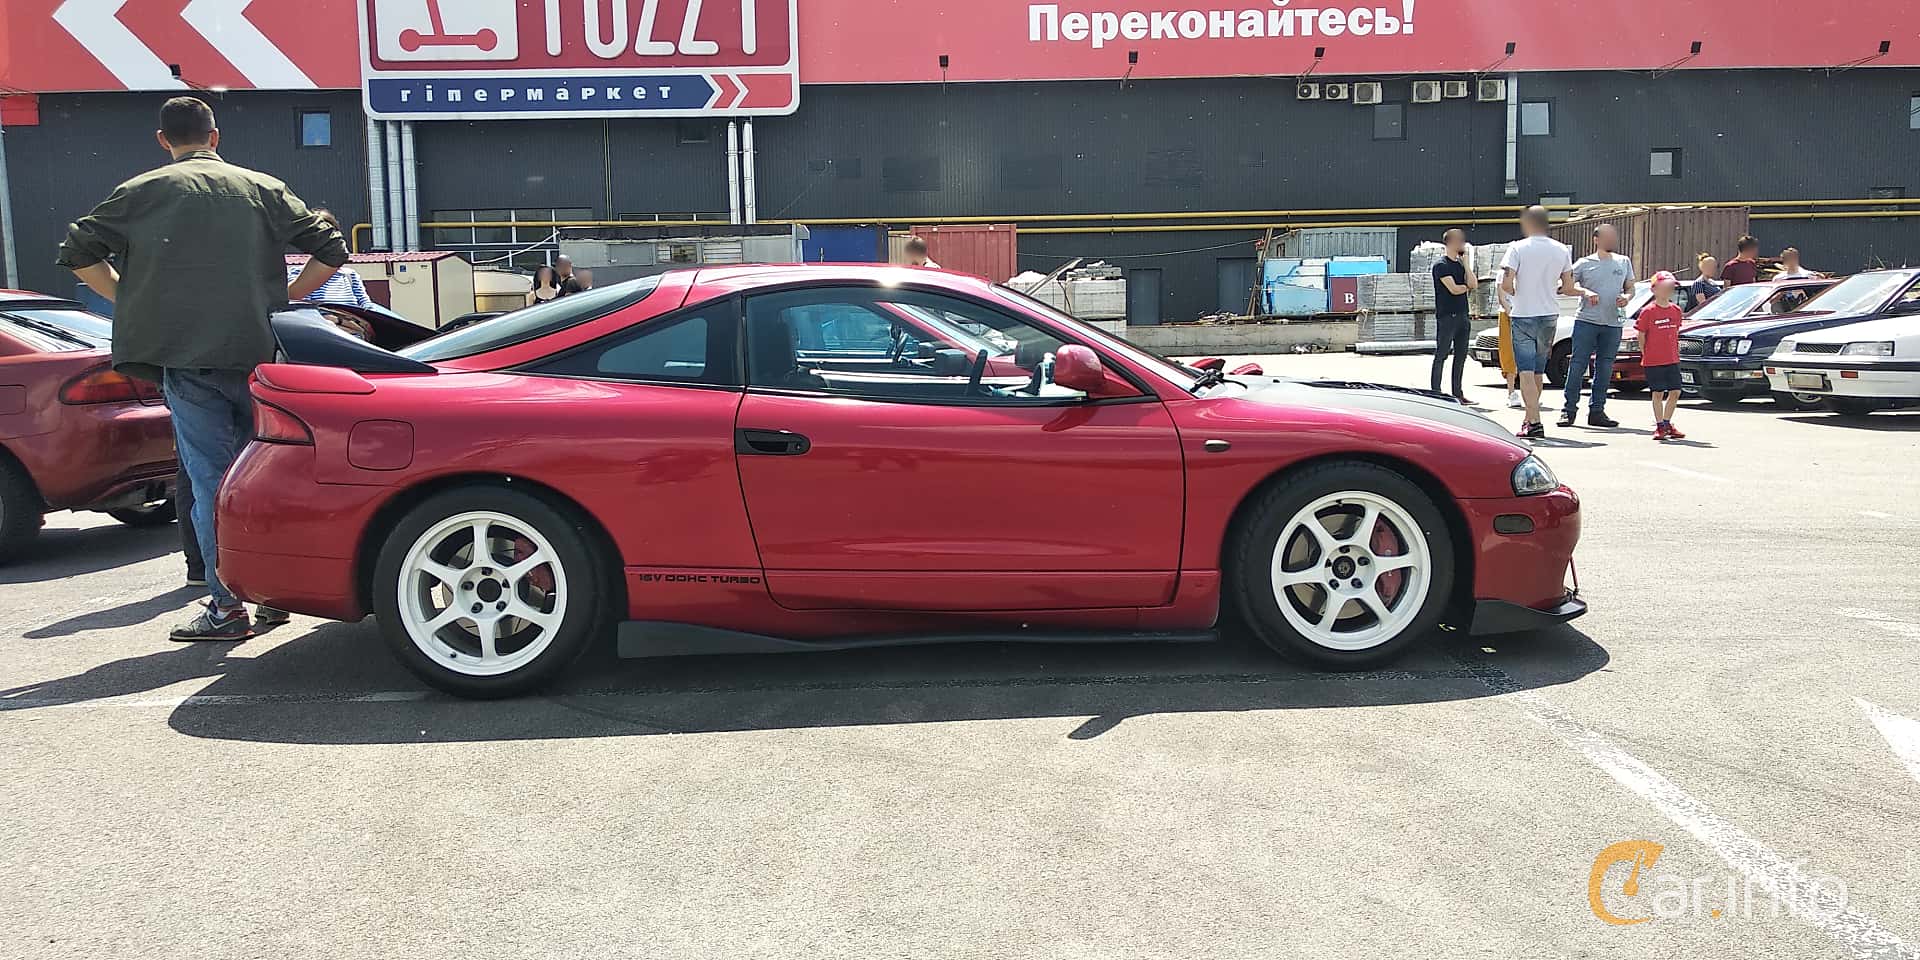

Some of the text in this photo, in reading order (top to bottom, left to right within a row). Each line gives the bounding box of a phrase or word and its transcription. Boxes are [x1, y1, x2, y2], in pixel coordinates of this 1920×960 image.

[1028, 0, 1415, 48] Переконайтесь!
[400, 84, 671, 102] гіпермаркет
[640, 573, 760, 584] 16V DOHC TURBO
